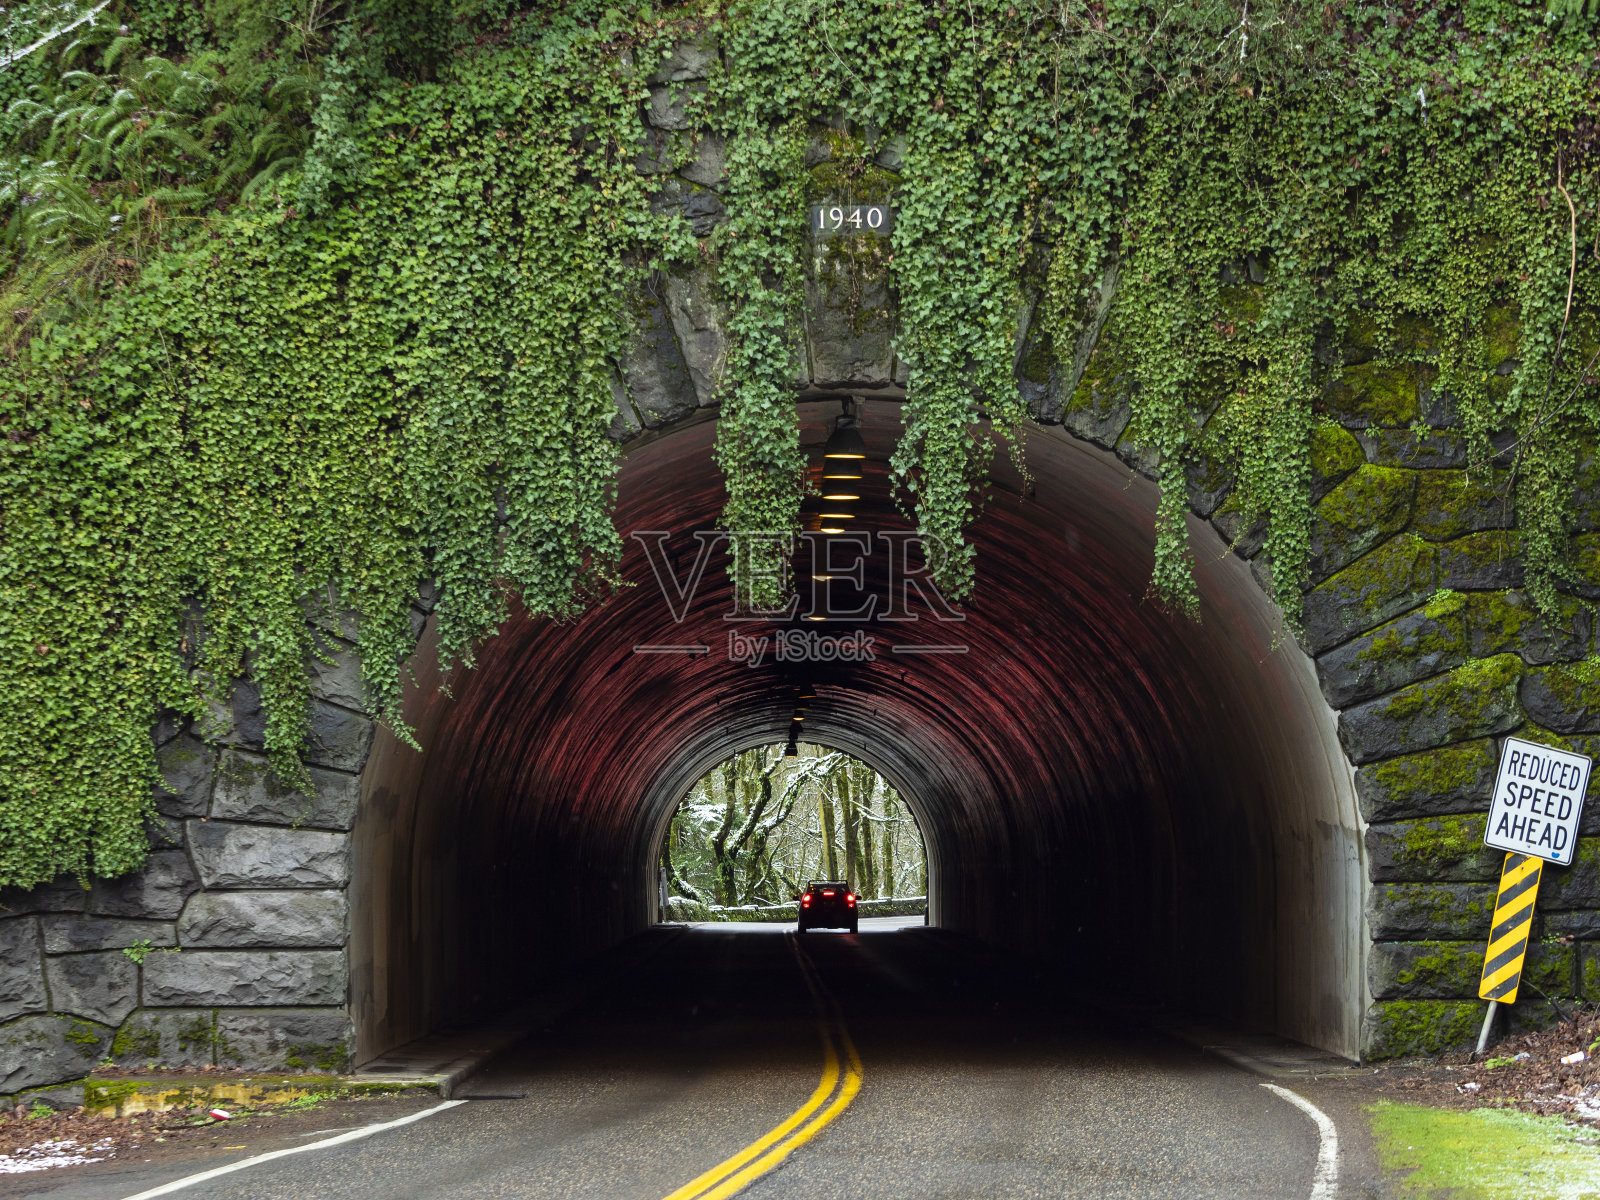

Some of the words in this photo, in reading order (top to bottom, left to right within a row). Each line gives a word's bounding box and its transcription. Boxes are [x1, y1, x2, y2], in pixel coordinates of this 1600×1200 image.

[819, 207, 883, 230] 1940
[1507, 750, 1581, 791] REDUCED
[1503, 781, 1573, 821] SPEED
[1495, 812, 1568, 851] AHEAD
